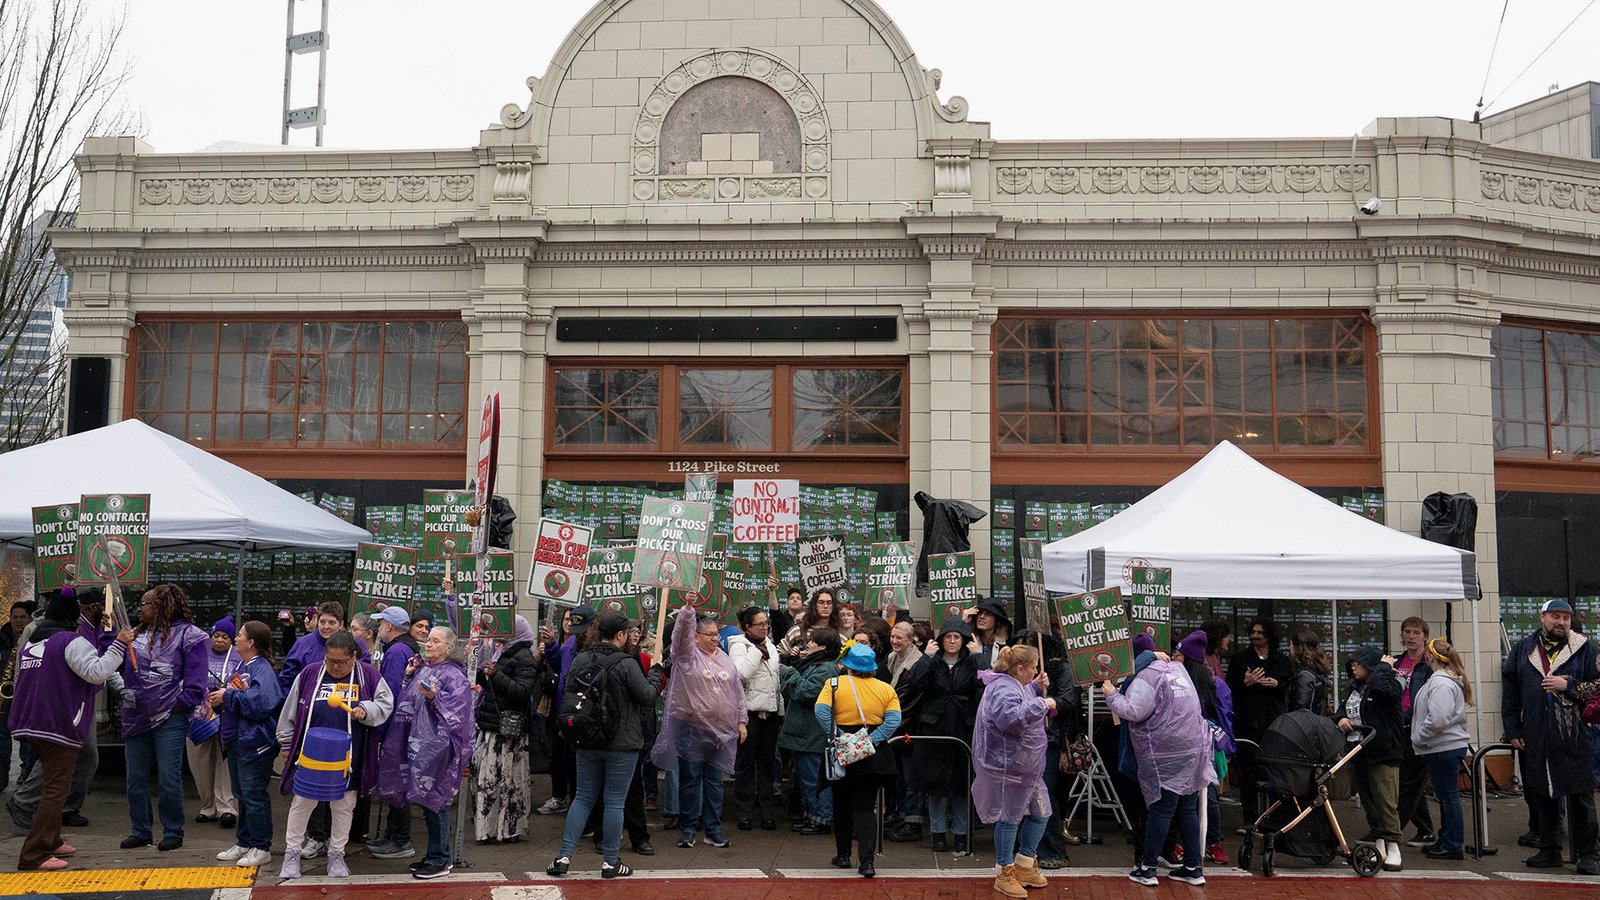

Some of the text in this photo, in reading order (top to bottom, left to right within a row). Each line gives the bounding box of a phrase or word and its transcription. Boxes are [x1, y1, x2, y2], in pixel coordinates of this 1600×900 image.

[668, 461, 780, 472] 1124 Pike Street
[686, 490, 716, 500] DON'T CROSS
[754, 481, 778, 498] NO
[425, 505, 447, 513] DON'T
[80, 512, 149, 523] NO CONTRACT,
[440, 514, 457, 522] OUR
[643, 515, 707, 532] DON'T CROSS
[754, 512, 775, 524] NO
[35, 522, 63, 534] DON'T
[79, 525, 149, 535] NO STARBUCKS!
[424, 523, 454, 532] PICKET
[734, 524, 799, 541] COFFEE!
[56, 532, 77, 543] OUR
[661, 529, 683, 540] OUR
[37, 543, 74, 557] PICKET
[538, 536, 588, 558] RED CUP
[639, 537, 704, 555] PICKET LINE
[811, 544, 825, 554] NO
[534, 549, 587, 570] REBELLION
[801, 548, 842, 566] CONTRACT?
[870, 555, 914, 566] BARISTAS
[356, 558, 416, 576] BARISTAS
[585, 563, 635, 575] BARISTA
[816, 564, 830, 575] NO
[884, 565, 896, 574] ON
[1022, 557, 1043, 572] BARISTAS
[376, 572, 393, 583] ON
[604, 574, 619, 584] ON
[807, 567, 844, 588] COFFEE!
[868, 573, 912, 586] STRIKE!
[929, 566, 976, 580] BARISTAS
[353, 580, 413, 599] STRIKE!
[945, 578, 958, 588] ON
[1132, 583, 1171, 596] BARISTAS
[585, 582, 640, 598] STRIKE!
[931, 586, 976, 602] STRIKE!
[1024, 582, 1046, 599] STRIKE!
[1144, 595, 1156, 606] ON
[1061, 604, 1125, 626] DON'T CROSS
[1132, 605, 1170, 621] STRIKE!
[1084, 620, 1106, 633] OUR
[1066, 627, 1130, 650] PICKET LINE
